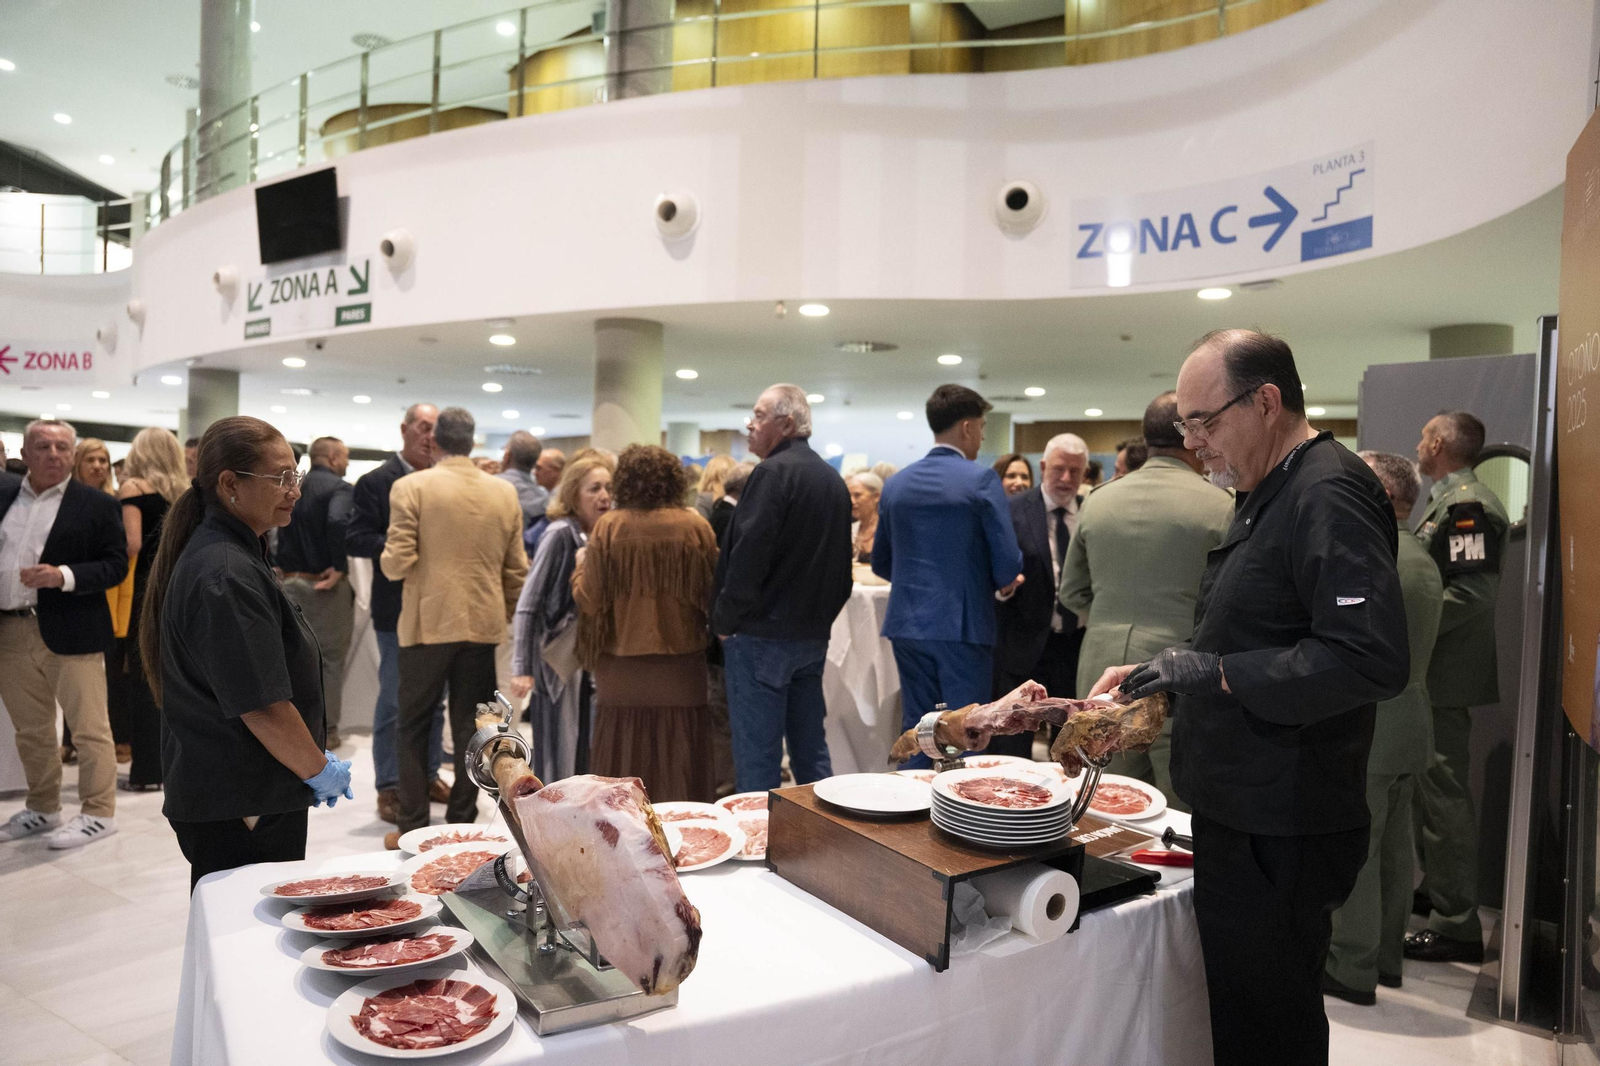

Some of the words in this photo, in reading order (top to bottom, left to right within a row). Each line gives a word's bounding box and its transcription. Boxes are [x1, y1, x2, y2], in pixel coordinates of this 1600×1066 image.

[1312, 153, 1356, 176] PLANTA
[1359, 149, 1365, 163] 3
[1076, 212, 1201, 259] ZONA
[1209, 205, 1238, 244] C
[270, 271, 321, 304] ZONA
[324, 268, 338, 296] A
[23, 351, 79, 370] ZONA
[82, 351, 92, 371] B
[1567, 387, 1587, 433] 2025
[1449, 533, 1486, 563] PM
